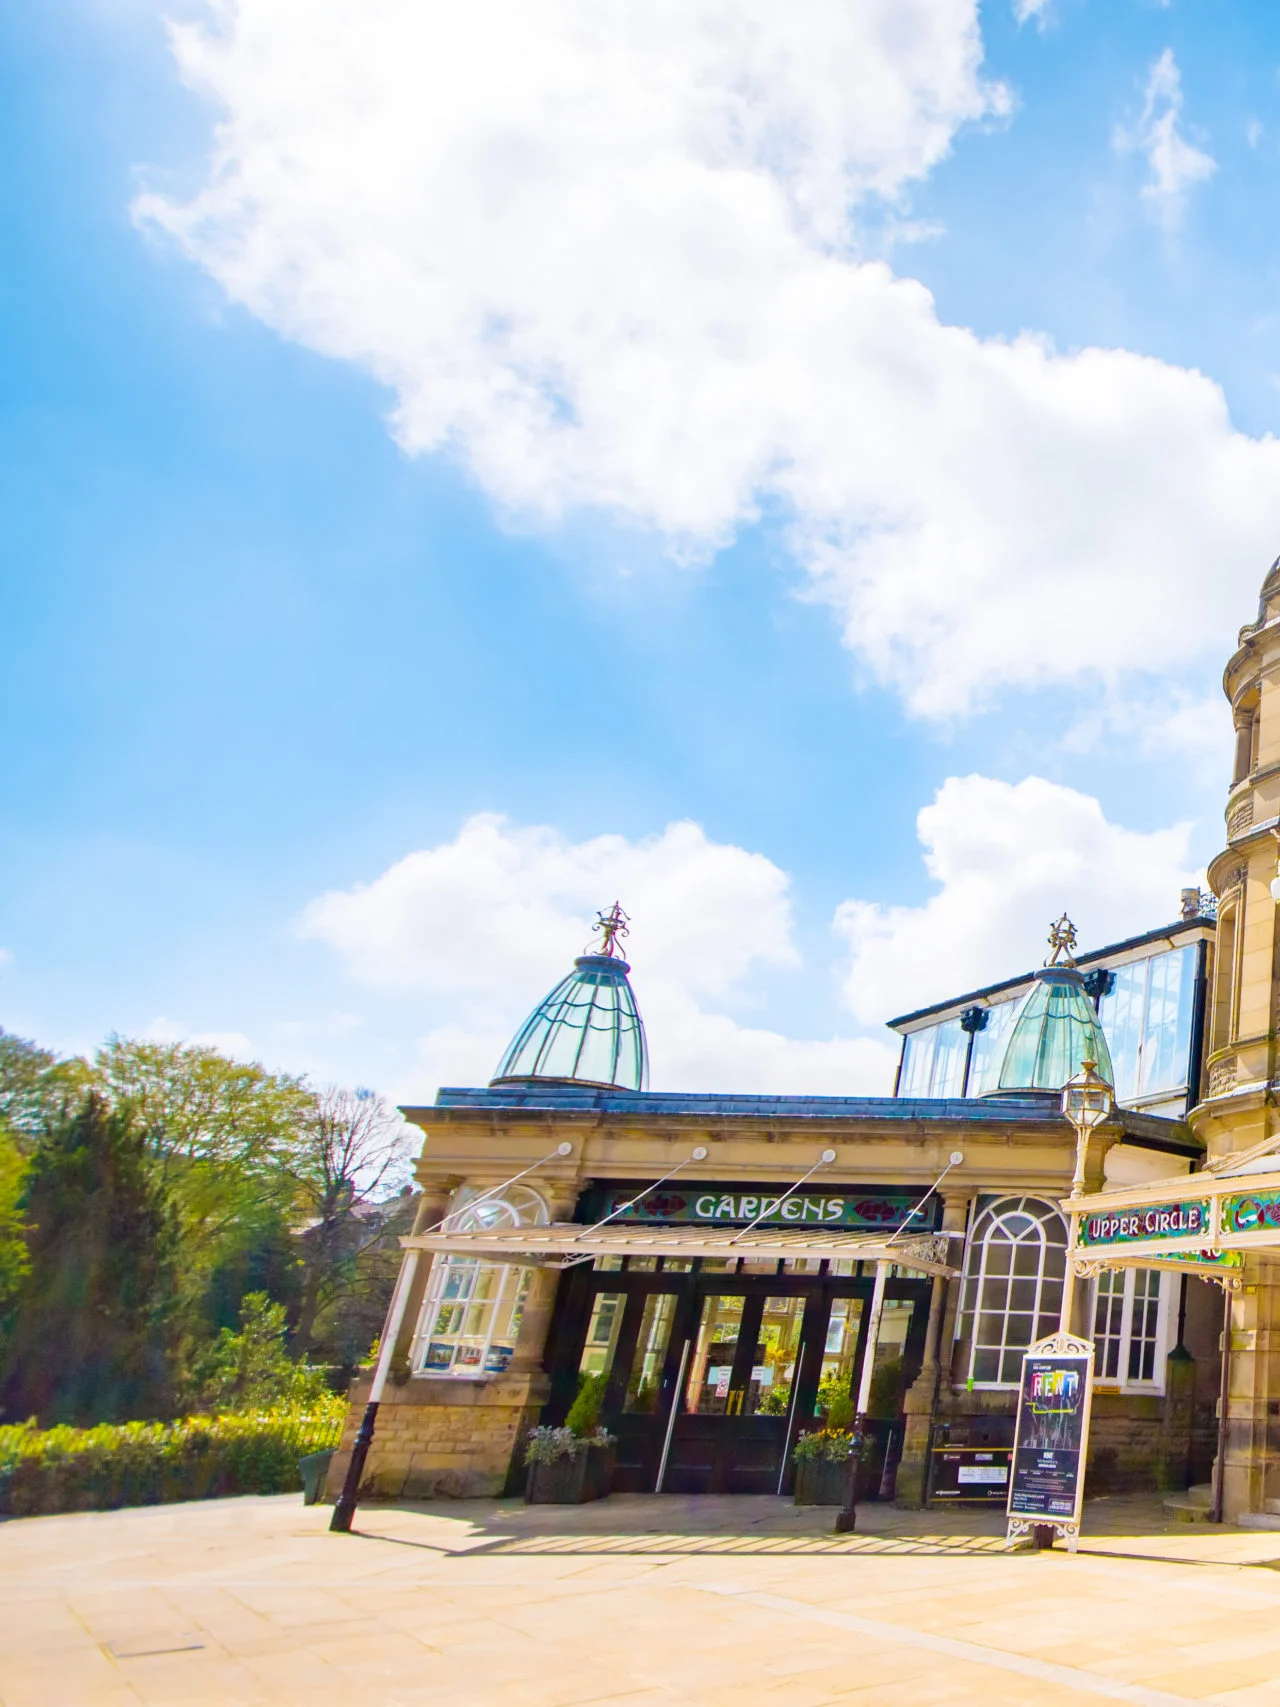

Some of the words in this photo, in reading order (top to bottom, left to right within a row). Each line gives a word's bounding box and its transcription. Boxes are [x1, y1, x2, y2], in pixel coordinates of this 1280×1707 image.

[695, 1195, 845, 1221] GARDENS
[1089, 1214, 1139, 1238] UPPER
[1145, 1208, 1200, 1233] CIRCLE
[1033, 1375, 1076, 1397] RENT
